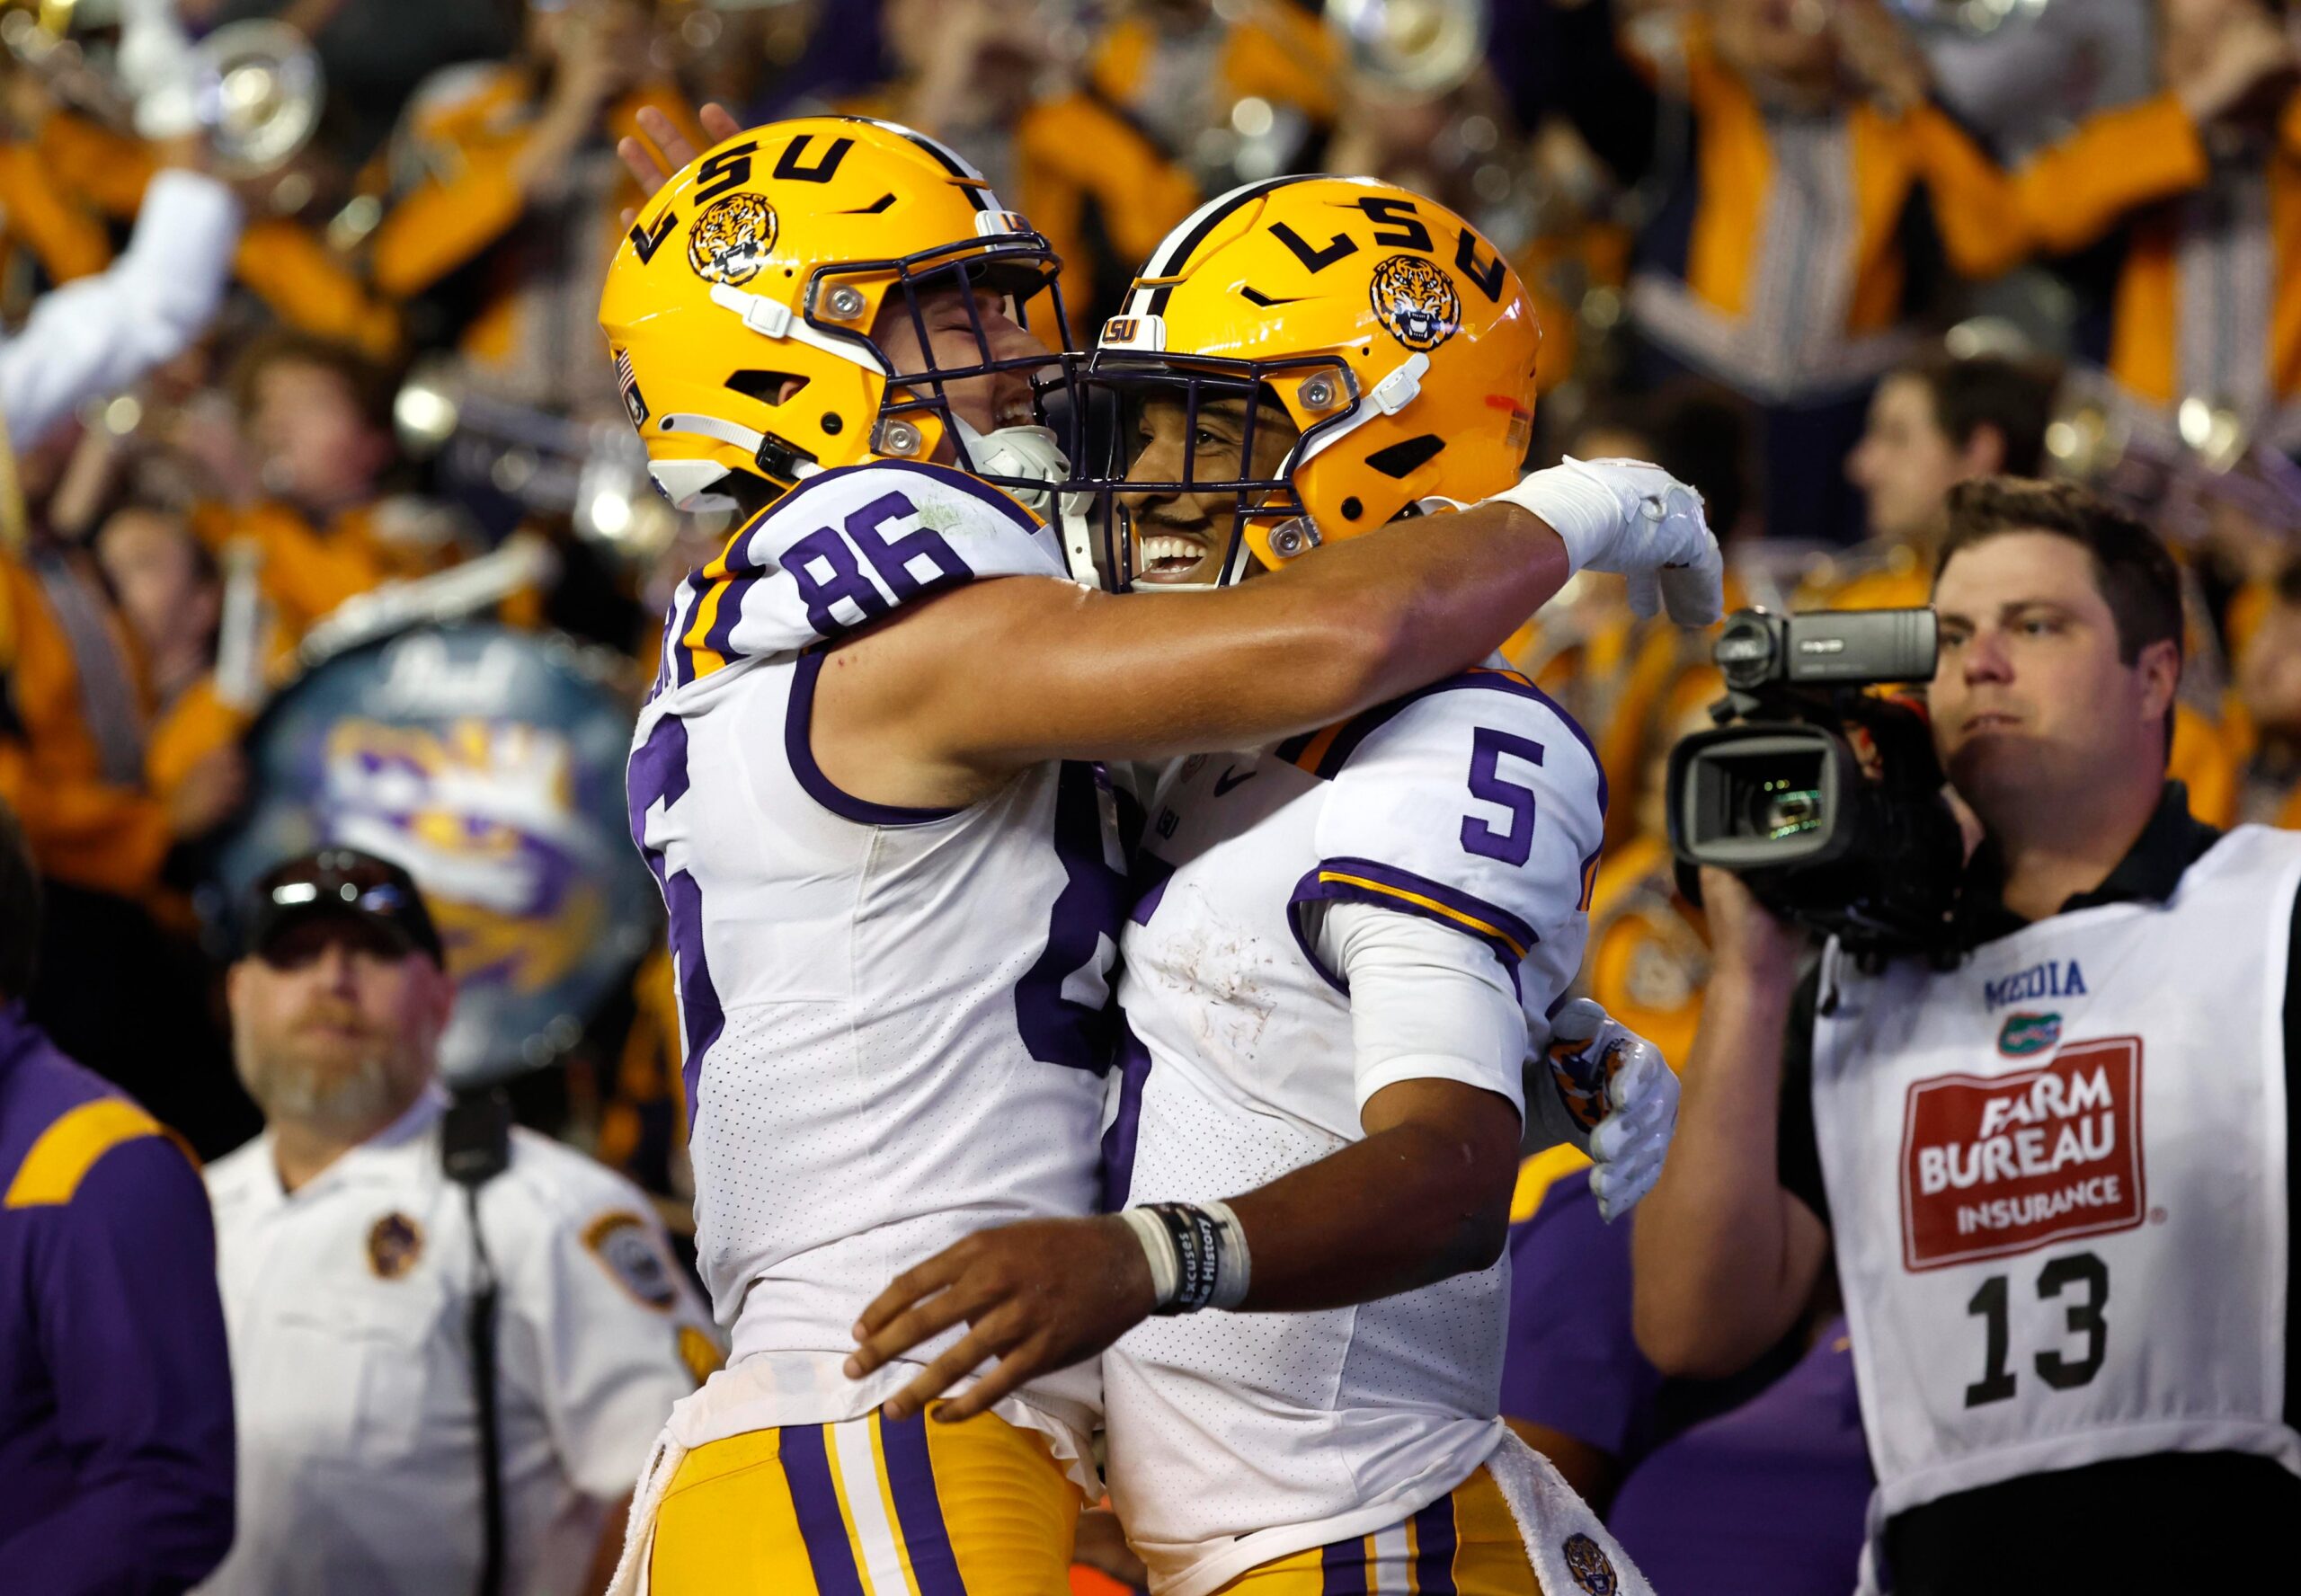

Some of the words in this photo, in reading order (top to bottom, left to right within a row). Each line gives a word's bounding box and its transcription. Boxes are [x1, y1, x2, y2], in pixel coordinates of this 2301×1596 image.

[629, 135, 855, 266] LSU
[1267, 197, 1506, 303] LSU
[1102, 318, 1140, 344] LSU
[778, 490, 975, 639] 86
[1460, 726, 1545, 868] 5
[1984, 959, 2088, 1013] MEDIA
[1979, 1064, 2114, 1139] FARM
[1918, 1110, 2115, 1195] BUREAU
[1957, 1175, 2121, 1236] INSURANCE
[1179, 1232, 1198, 1302] Excuses
[1196, 1217, 1215, 1281] History
[1965, 1250, 2110, 1408] 13
